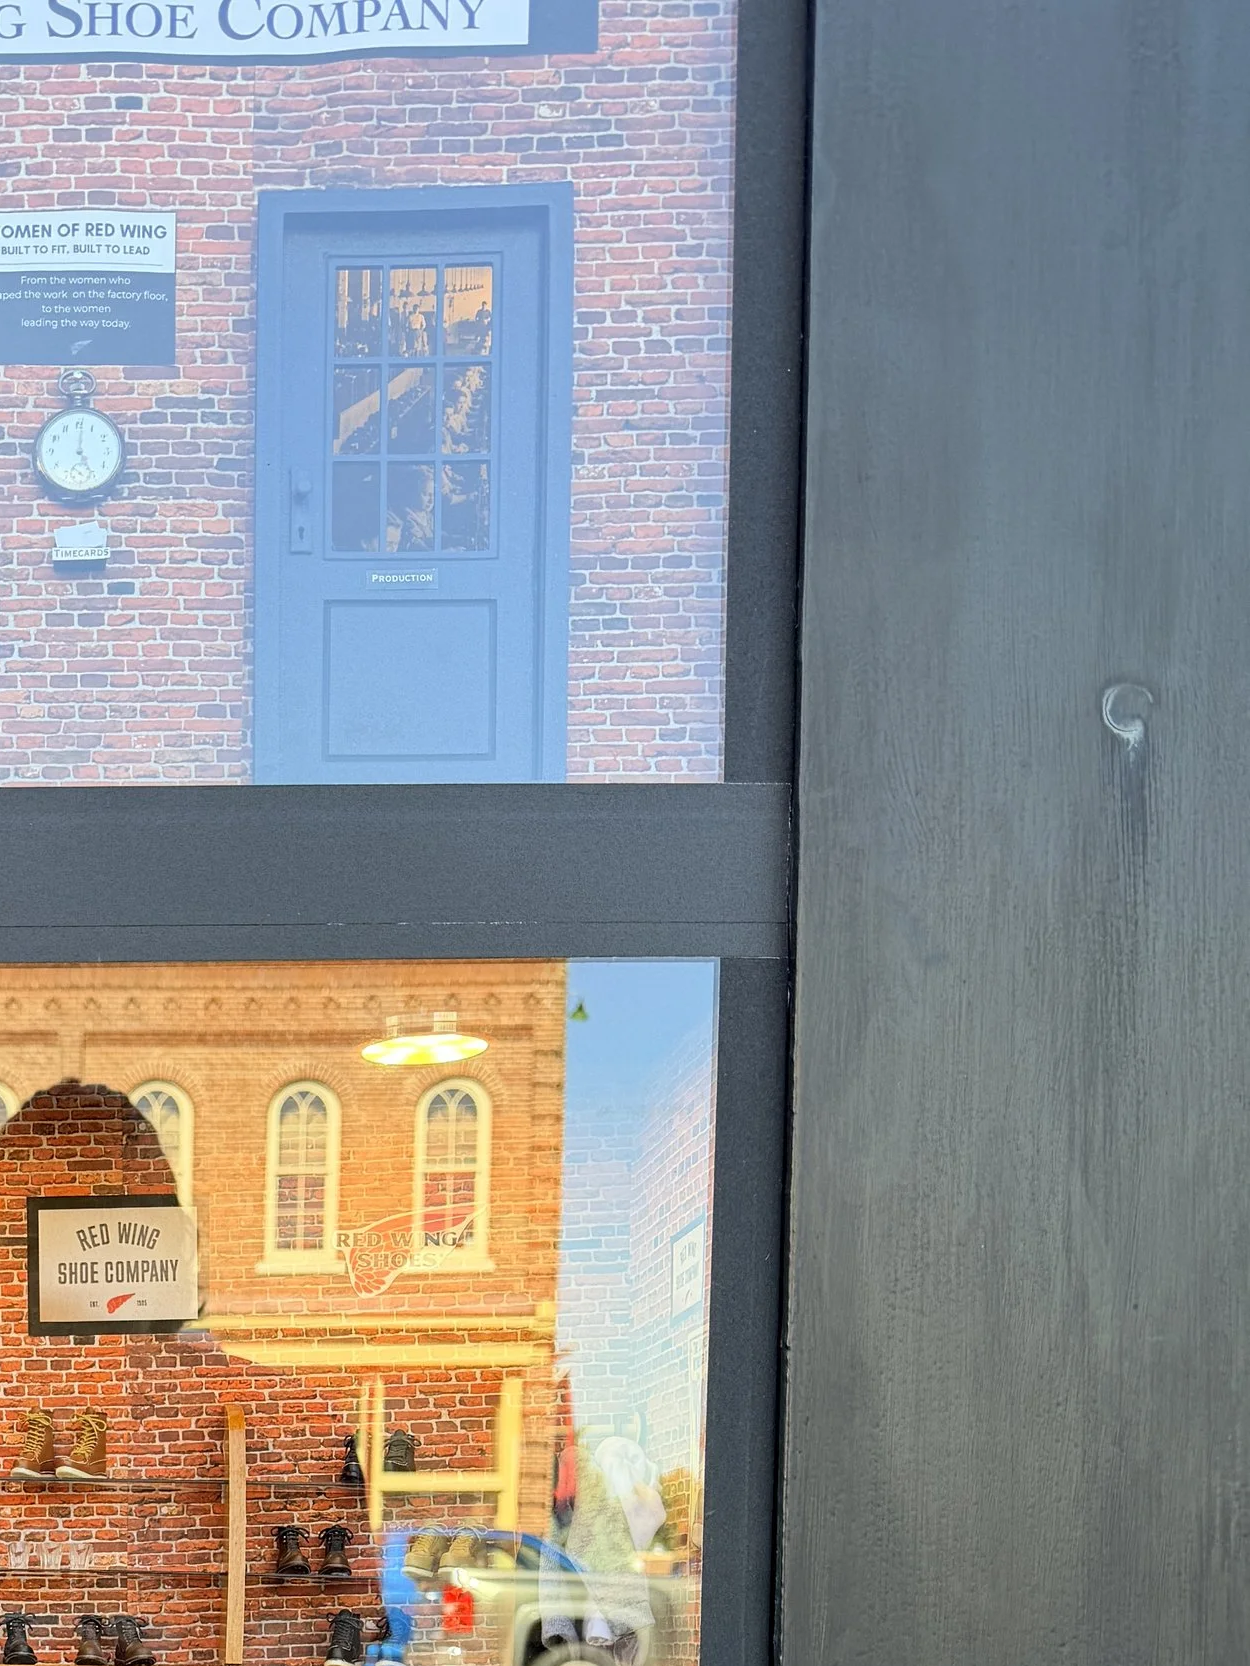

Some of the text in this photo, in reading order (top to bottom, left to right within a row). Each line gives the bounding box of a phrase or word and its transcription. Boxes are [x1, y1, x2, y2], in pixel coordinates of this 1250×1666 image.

[46, 0, 199, 41] SHOE
[238, 0, 486, 41] COMPANY
[57, 223, 80, 238] OF
[85, 223, 115, 237] RED
[120, 224, 168, 239] WING
[1, 246, 31, 256] BUILT
[34, 245, 49, 254] TO
[73, 244, 101, 254] BUILT
[104, 245, 120, 254] TO
[123, 246, 150, 256] LEAD
[20, 276, 131, 285] From the women who
[24, 290, 41, 299] the
[44, 290, 68, 299] work
[72, 291, 85, 299] on
[88, 290, 105, 299] the
[107, 290, 141, 302] factory
[143, 291, 168, 301] floor,
[41, 305, 52, 313] to
[54, 305, 71, 313] the
[21, 319, 131, 329] leading the way today.
[54, 548, 110, 558] TIMECARDS
[371, 574, 433, 583] PRODUCTION
[76, 1221, 161, 1251] RED WING
[336, 1232, 458, 1248] RED WNG
[58, 1259, 179, 1285] SHOE COMPANY
